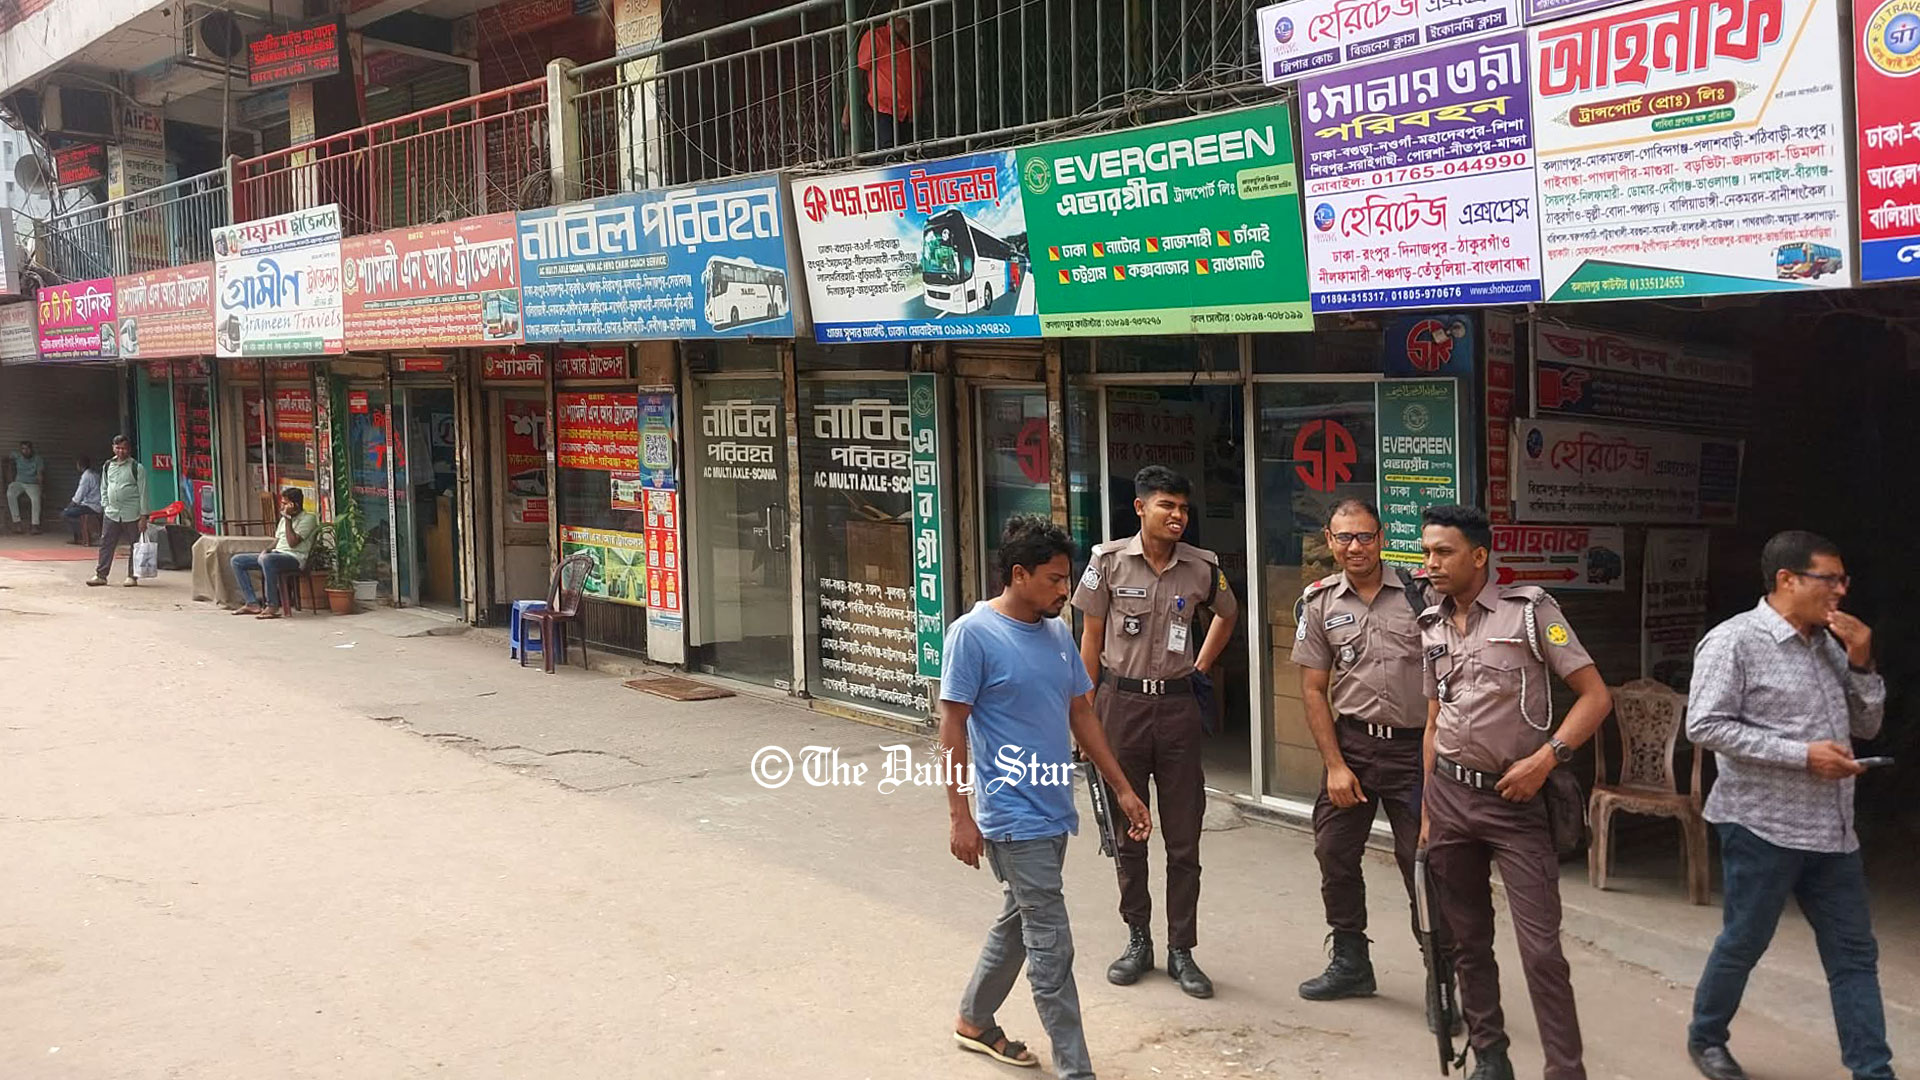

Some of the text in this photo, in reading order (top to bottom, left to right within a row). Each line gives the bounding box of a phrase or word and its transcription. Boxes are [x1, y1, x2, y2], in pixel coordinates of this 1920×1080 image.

[1429, 14, 1502, 40] ইকোনমি ক্লাস
[1350, 33, 1416, 59] বিজনেস ক্লাস
[1539, 0, 1786, 97] আহনাফ
[1311, 53, 1334, 68] কোচ
[1306, 66, 1438, 123] সোনার
[1697, 86, 1726, 106] লিঃ
[1314, 96, 1513, 141] পরিবহন
[1054, 125, 1276, 186] EVERGREEN
[1372, 153, 1526, 185] 01765-044990
[1056, 176, 1169, 217] এভারগ্রীন
[1218, 179, 1236, 197] লিঃ
[520, 186, 780, 261] নাবিল পরিবহন
[1341, 193, 1530, 237] হেরিটেজ এক্সপ্রেস
[1062, 223, 1270, 258] ঢাকা নাটোর রাজশাহী চাঁপাই
[355, 239, 398, 295] শ্যামলী
[1071, 265, 1107, 284] চট্টগ্রাম
[1127, 260, 1189, 279] কক্সবাজার
[222, 257, 304, 311] গ্রামীণ
[1321, 292, 1387, 304] 01894-815317,
[1391, 288, 1462, 301] 01805-970676
[40, 301, 50, 326] কে
[52, 292, 60, 323] টি
[74, 286, 112, 322] হানিফ
[295, 309, 341, 329] Travels
[495, 354, 544, 375] শ্যামলী
[702, 399, 777, 437] নাবিল
[708, 441, 773, 465] পরিবহন
[831, 445, 912, 472] পরিবহ
[1293, 419, 1358, 493] SR
[1382, 436, 1452, 454] EVERGREEN
[1550, 431, 1652, 477] হেরিটেজ
[703, 467, 777, 481] AC MULTI AXLE-SCANIA
[813, 471, 828, 487] AC
[829, 472, 859, 490] MULTI
[1390, 484, 1455, 498] ঢাকা নাটোর
[1390, 501, 1418, 516] রাজশাহী
[1492, 526, 1591, 552] আহনাফ
